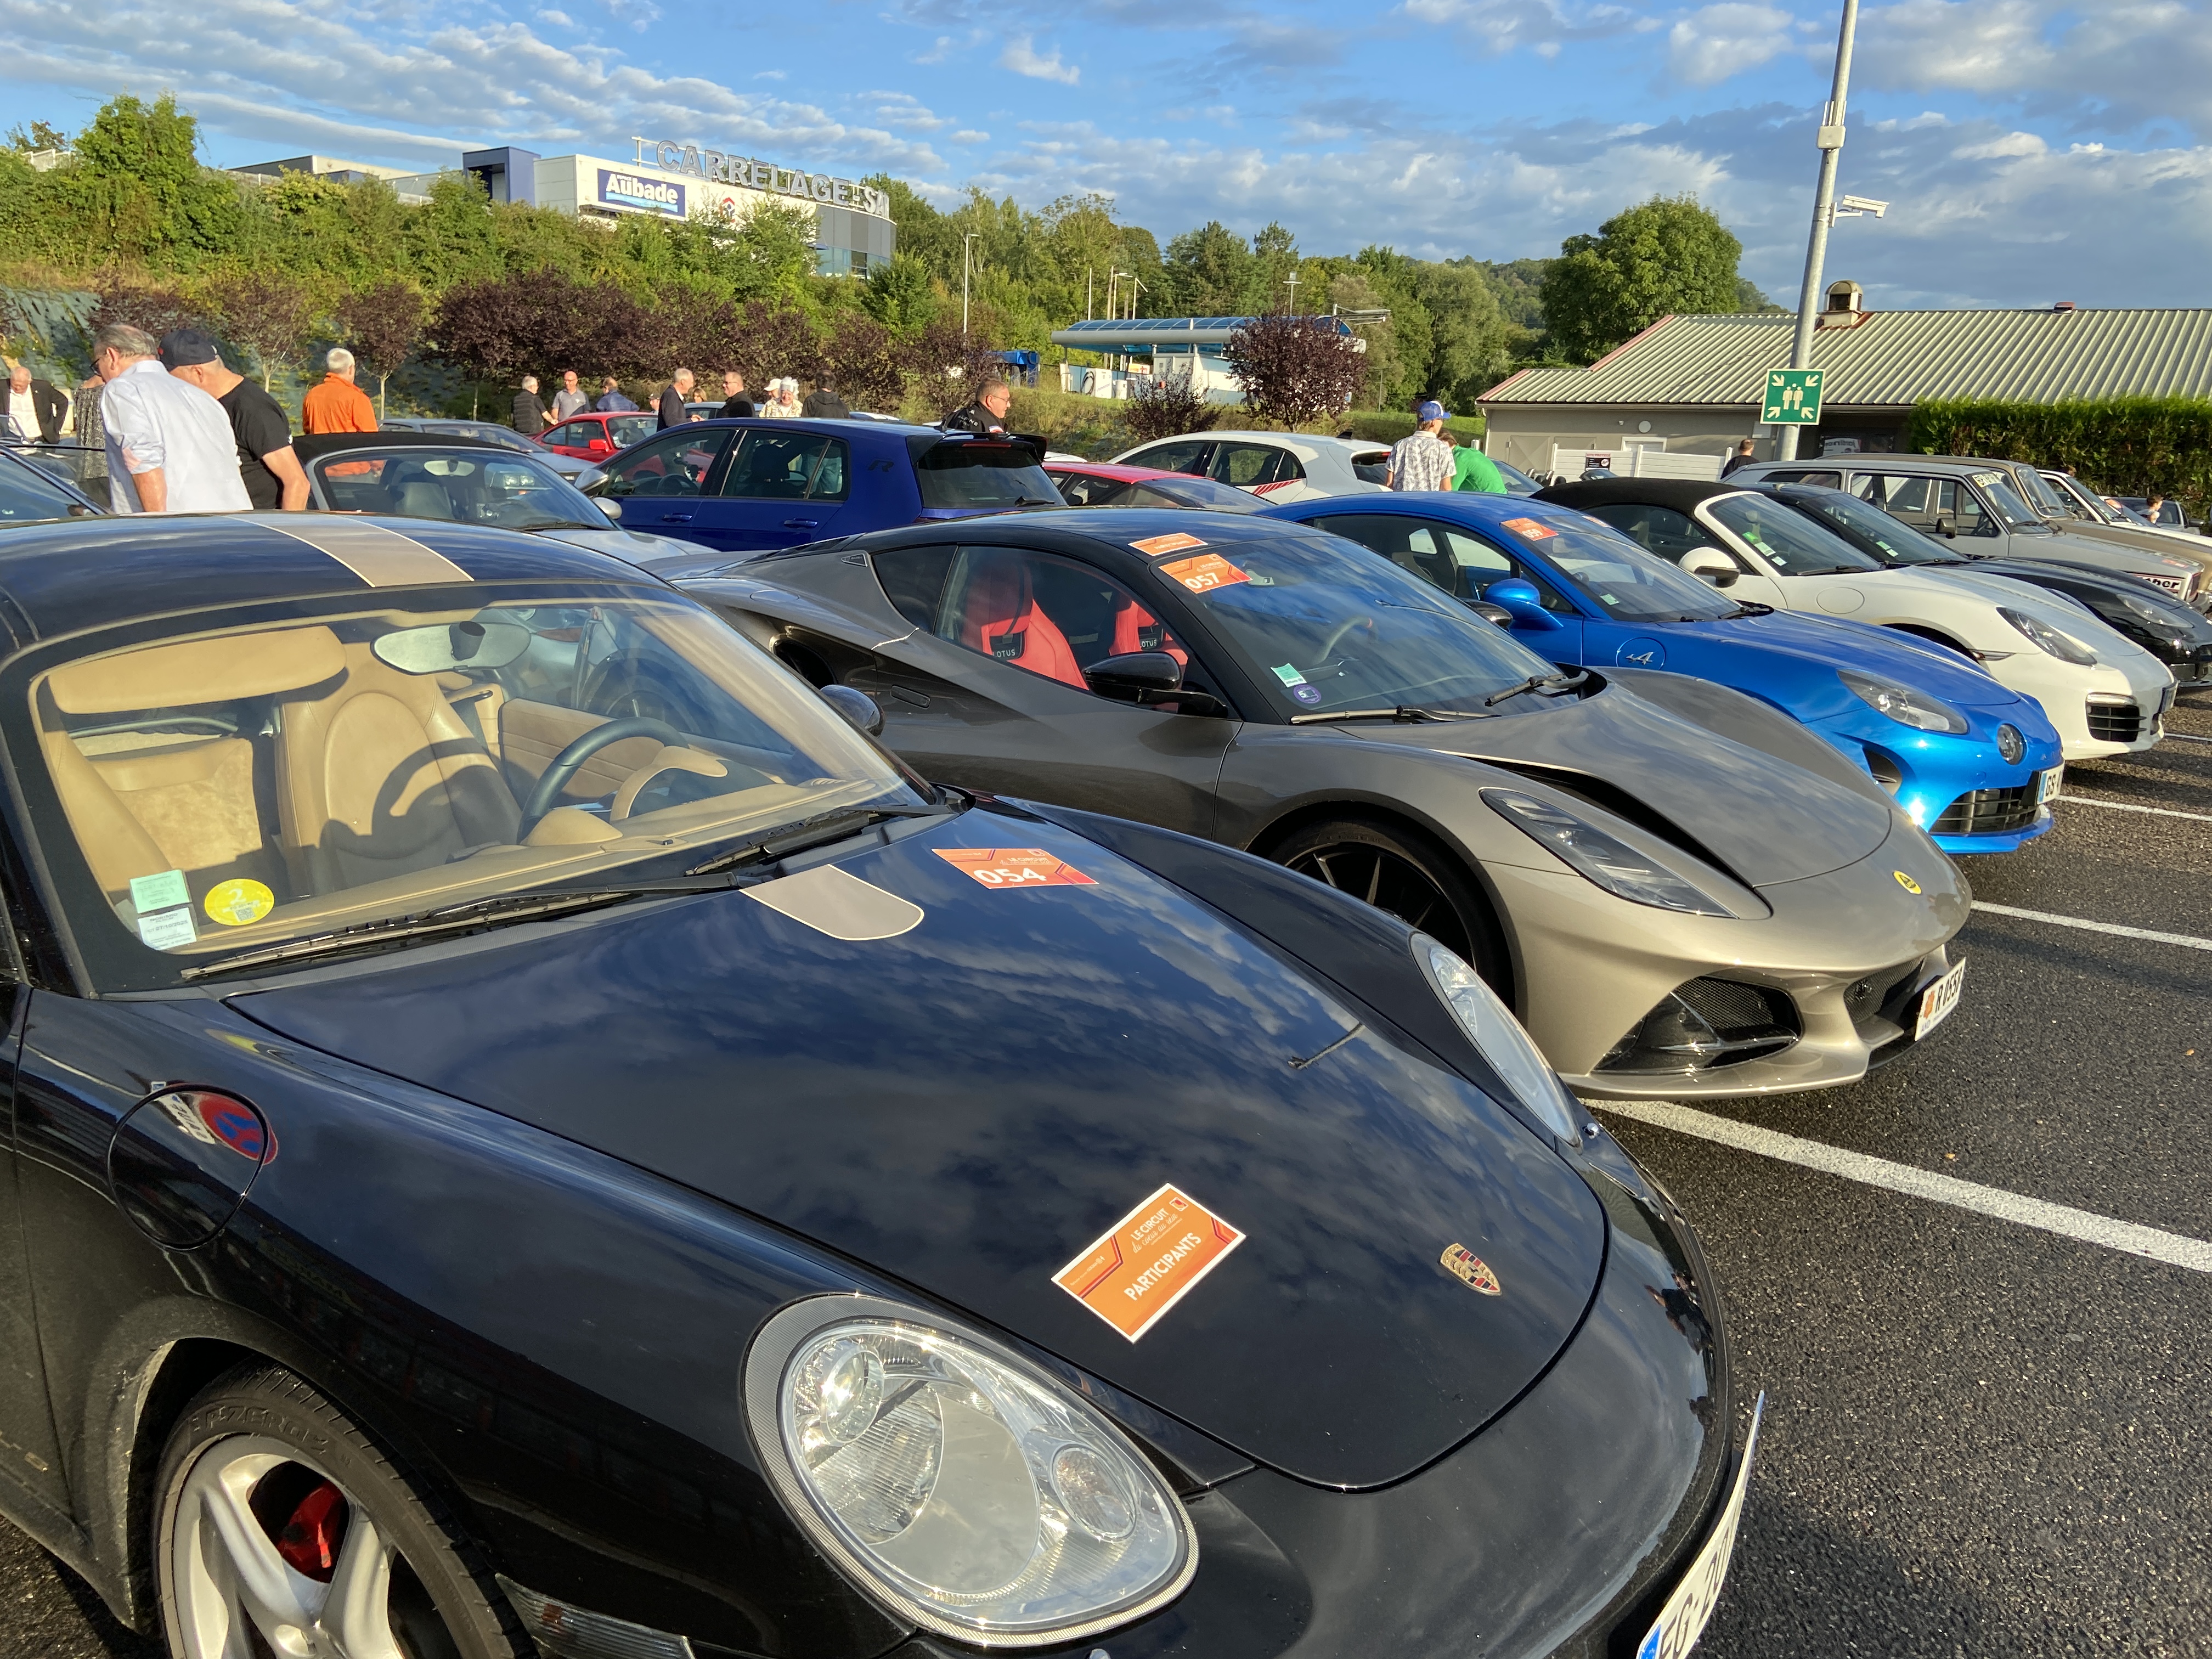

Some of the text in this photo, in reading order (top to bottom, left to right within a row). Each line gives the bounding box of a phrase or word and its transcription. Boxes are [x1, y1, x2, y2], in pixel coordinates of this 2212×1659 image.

[1521, 528, 1543, 538] 059
[1185, 572, 1220, 589] 057
[1139, 639, 1157, 648] OTUS
[973, 867, 1047, 884] 054
[228, 888, 246, 905] 2
[1130, 1229, 1144, 1241] LE
[1141, 1207, 1170, 1234] CIRCUIT
[1132, 1241, 1142, 1254] du
[1141, 1231, 1159, 1248] coeur
[1158, 1222, 1167, 1233] au
[1124, 1232, 1201, 1301] PARTICIPANTS
